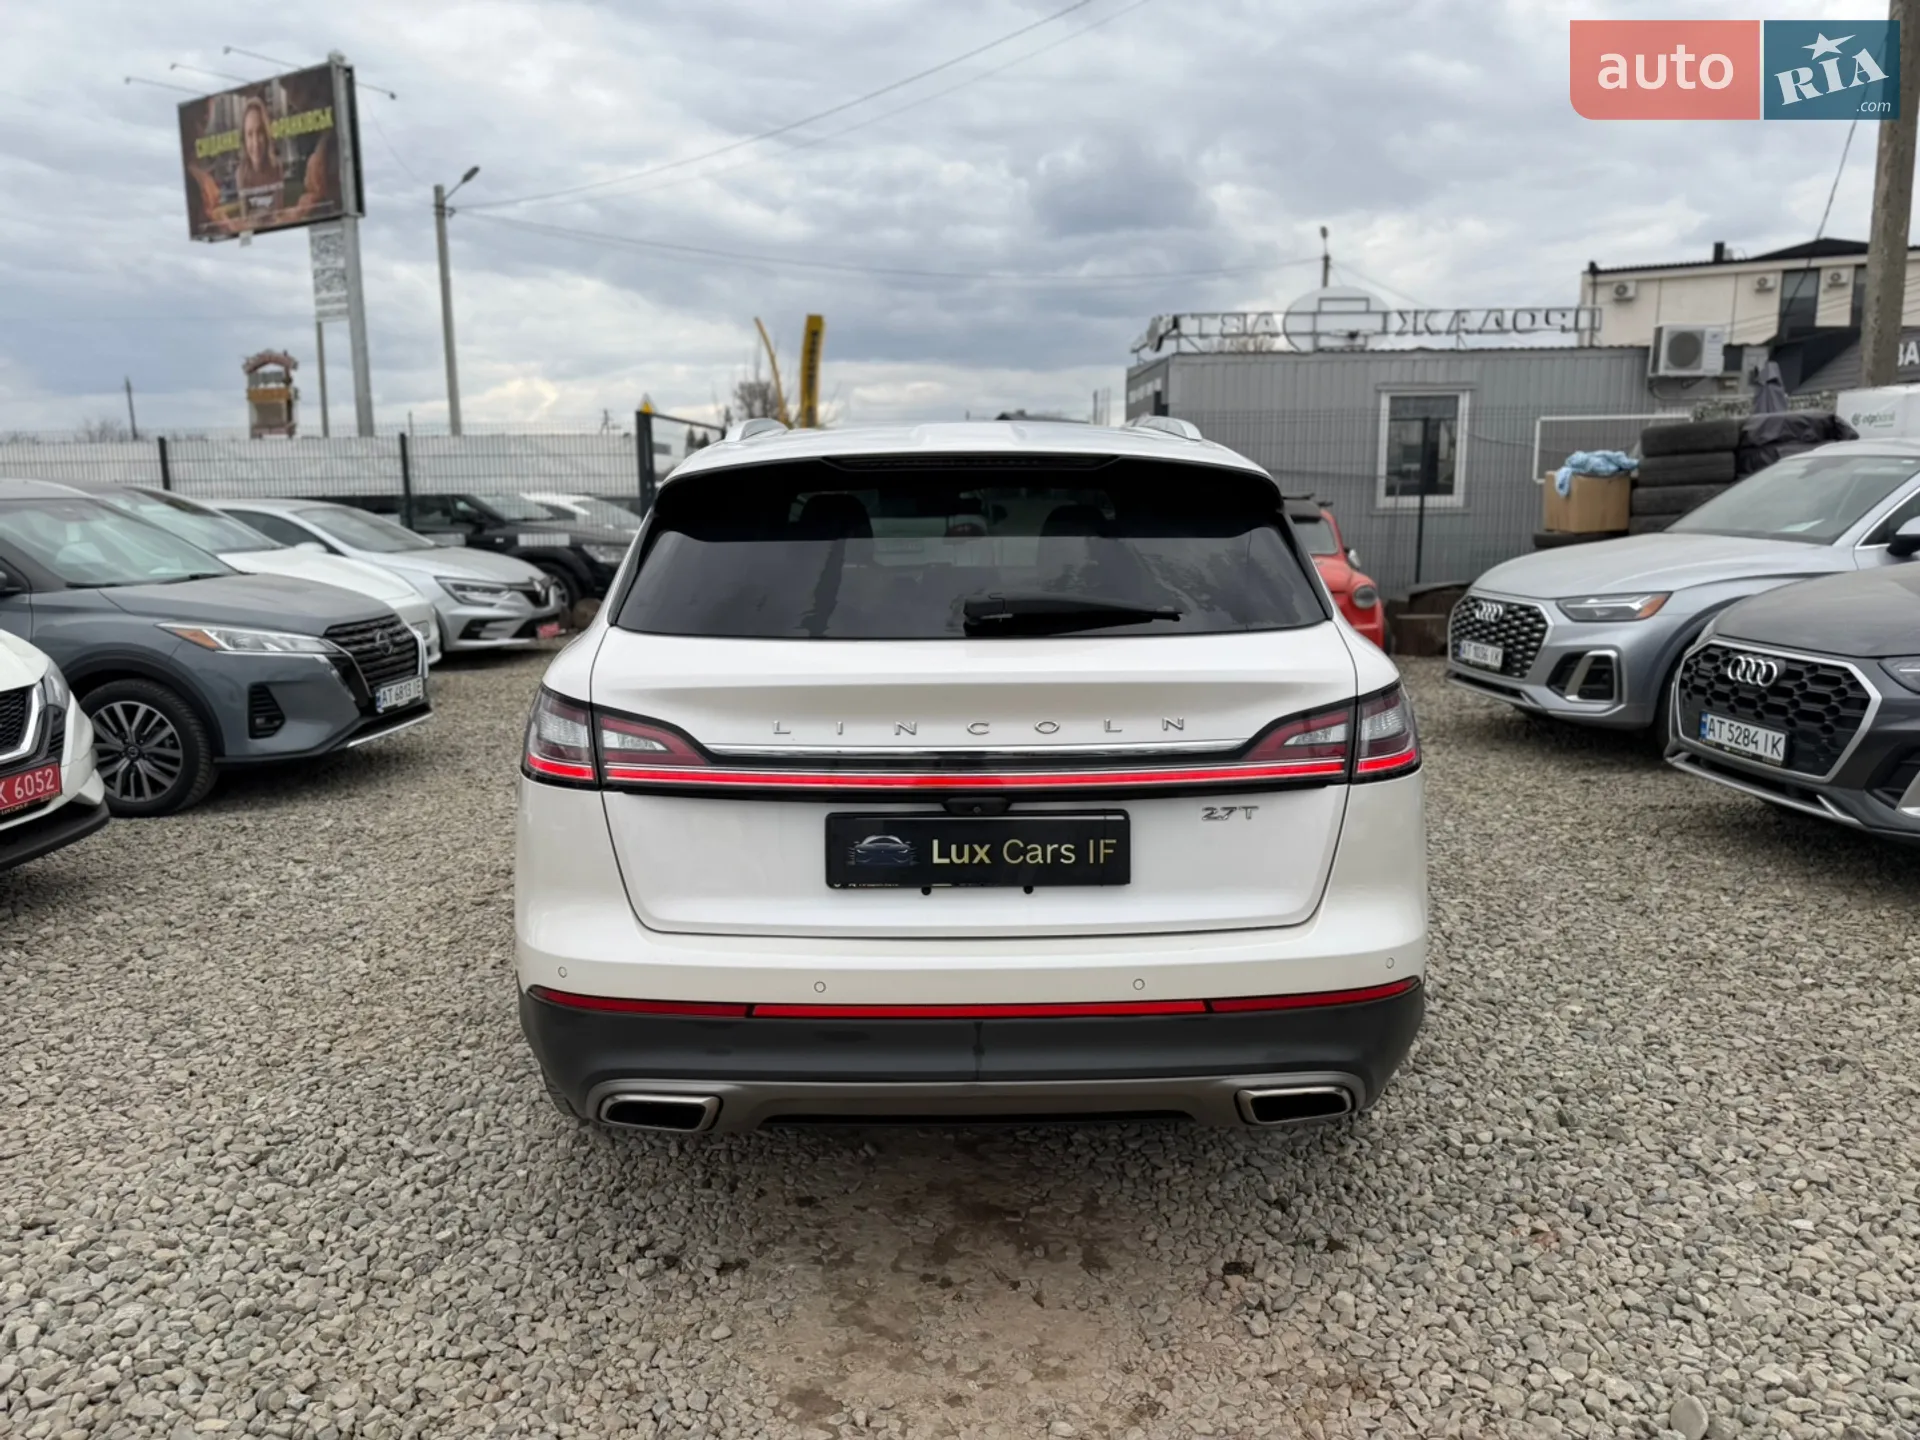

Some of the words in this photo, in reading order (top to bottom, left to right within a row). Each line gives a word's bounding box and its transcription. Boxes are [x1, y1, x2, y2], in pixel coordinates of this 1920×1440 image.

[773, 717, 1185, 736] LINCOLN
[1708, 718, 1725, 738] AT
[1727, 722, 1759, 751] 5284
[1764, 733, 1783, 757] IK
[14, 769, 54, 799] 6052
[932, 838, 992, 864] Lux
[1002, 838, 1076, 864] Cars
[1088, 839, 1117, 864] IF
